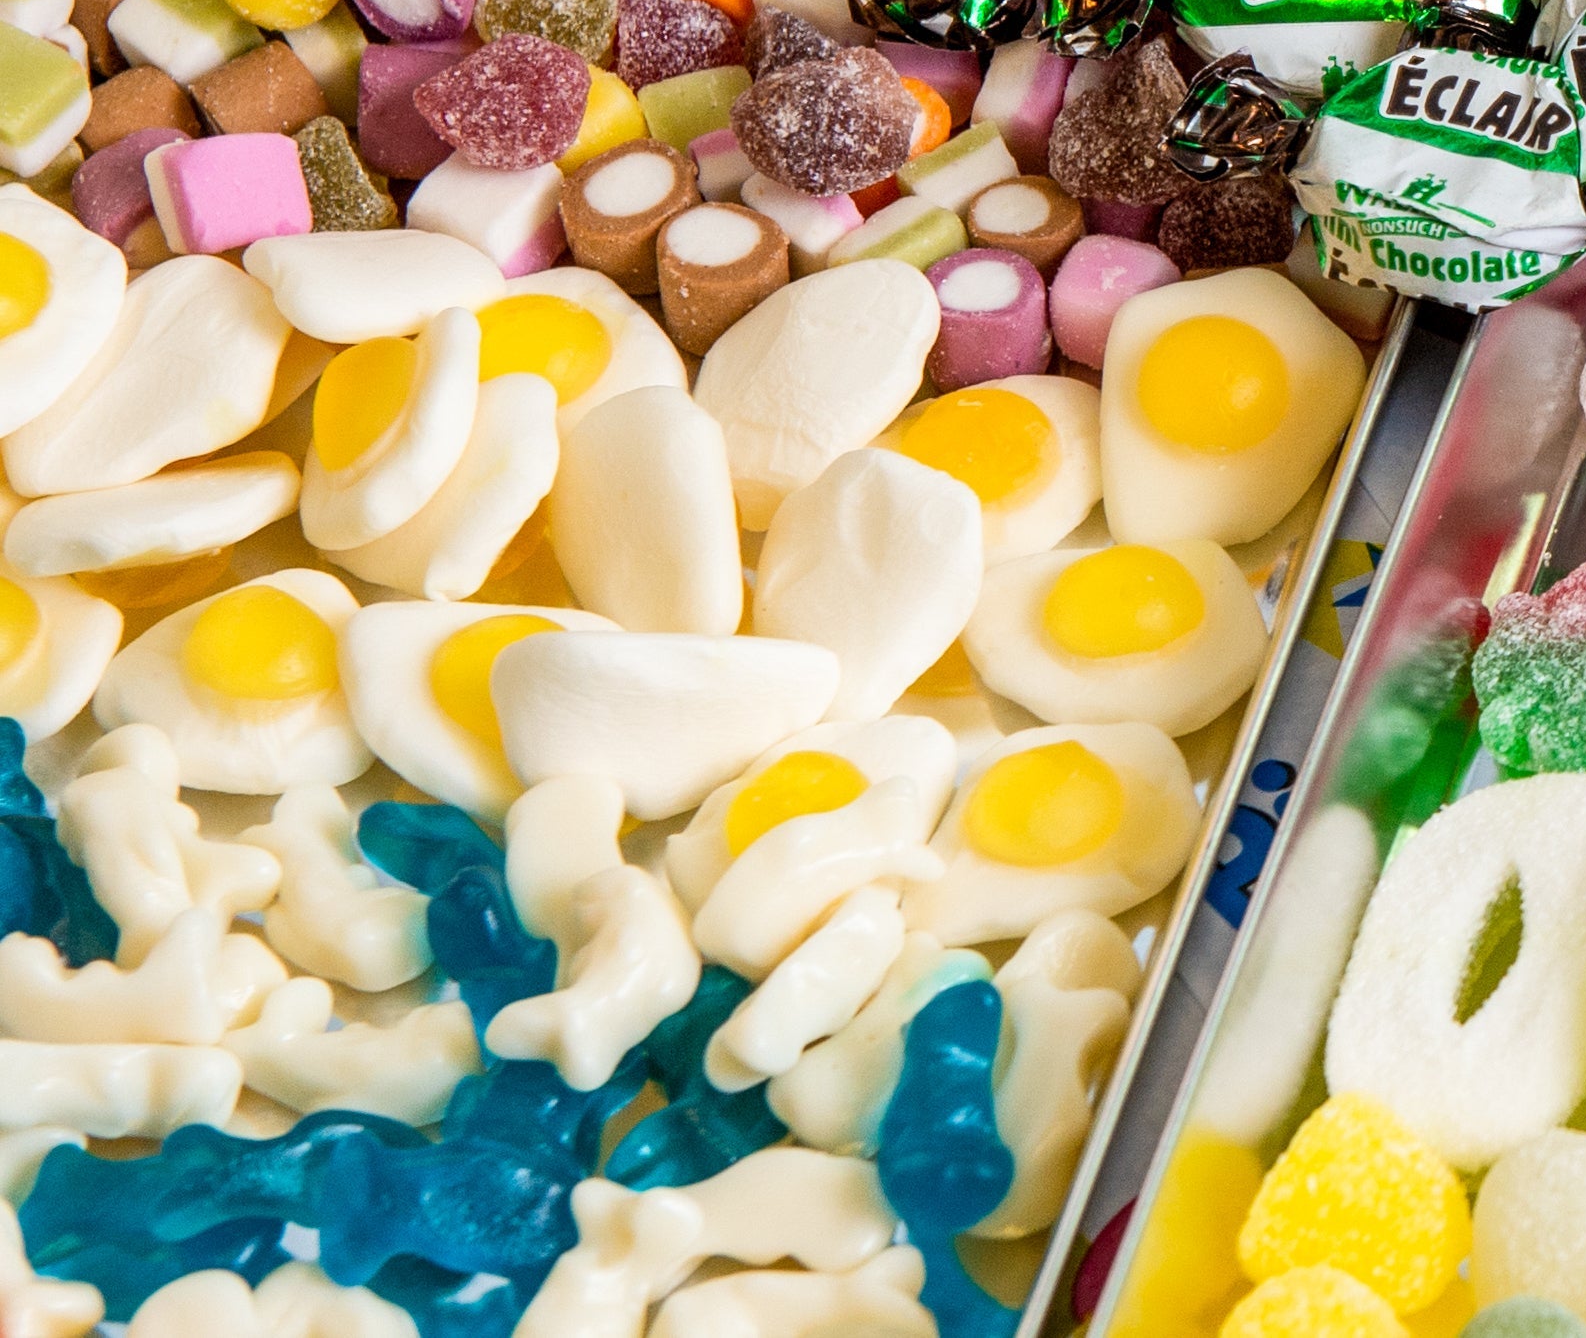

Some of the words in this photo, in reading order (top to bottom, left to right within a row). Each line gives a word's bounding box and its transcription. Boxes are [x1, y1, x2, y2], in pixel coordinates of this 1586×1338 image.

[1385, 55, 1573, 152] ÉCLAIR
[1360, 218, 1444, 239] NONSUCH
[1369, 238, 1541, 283] Chocolate
